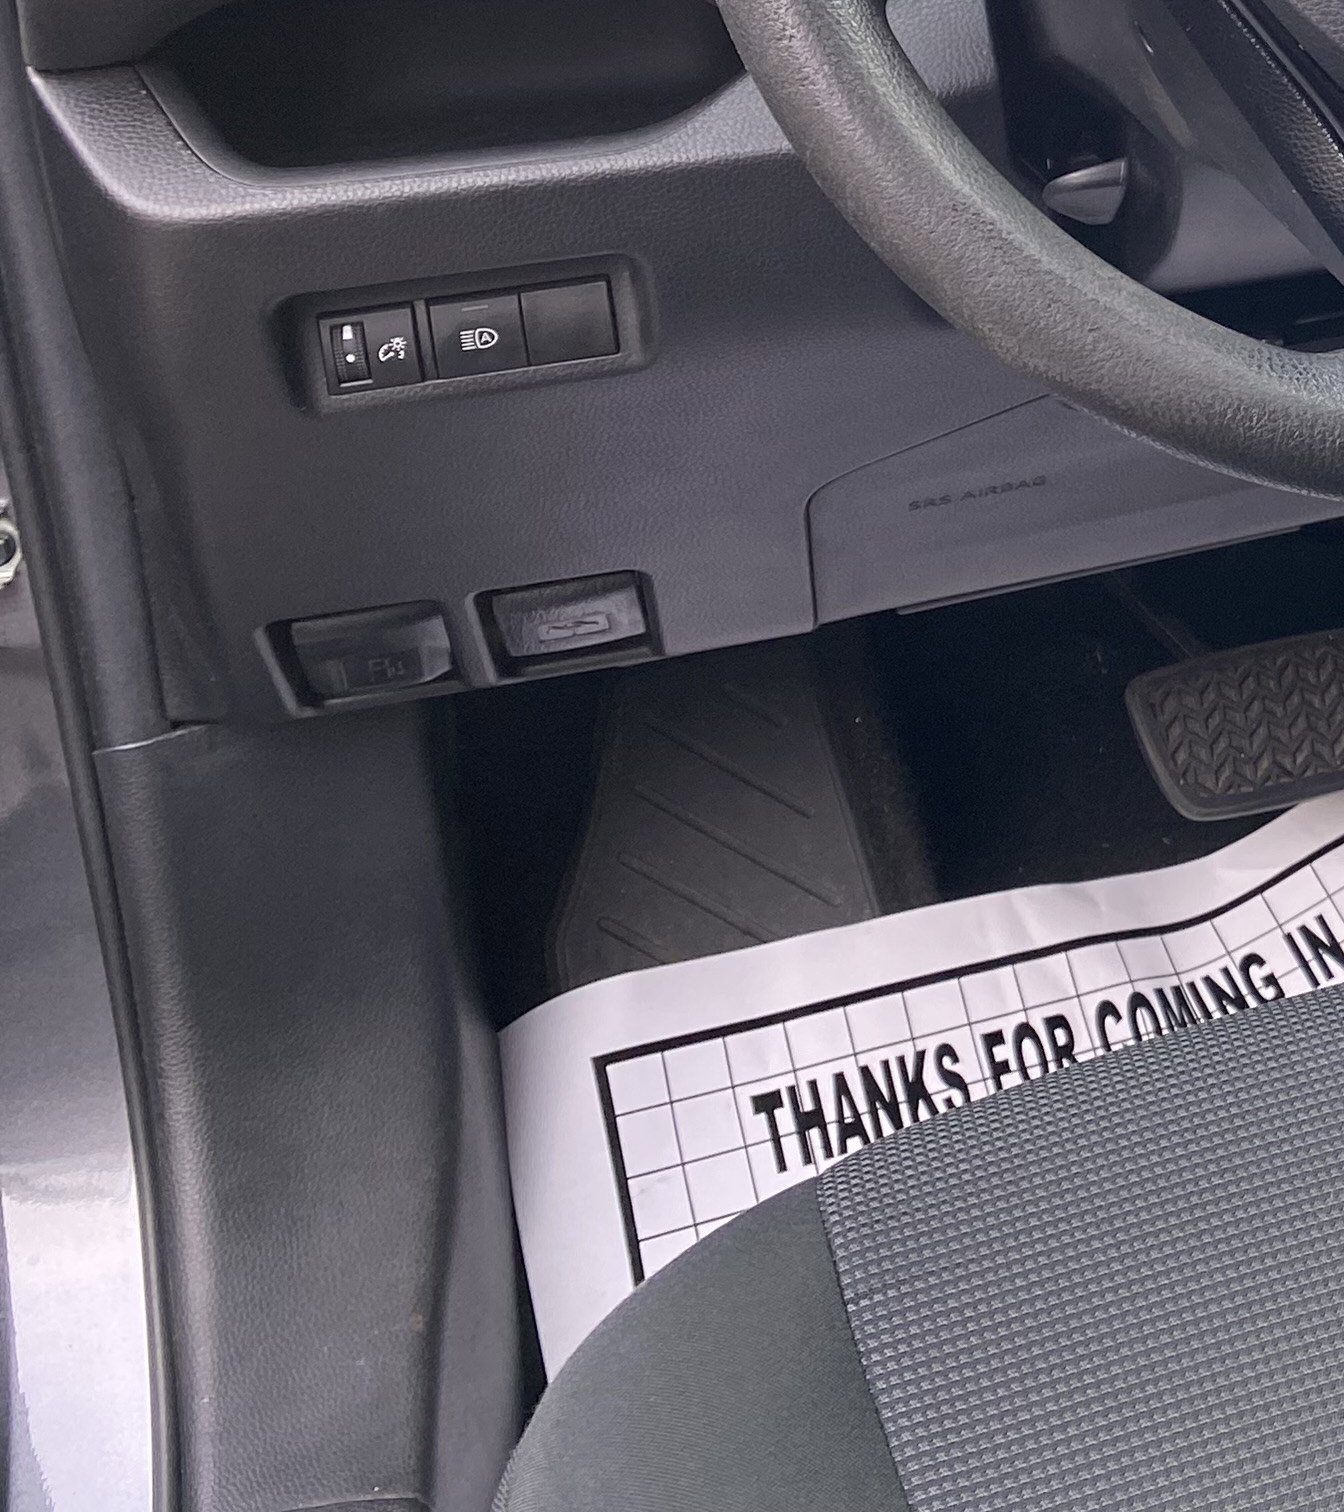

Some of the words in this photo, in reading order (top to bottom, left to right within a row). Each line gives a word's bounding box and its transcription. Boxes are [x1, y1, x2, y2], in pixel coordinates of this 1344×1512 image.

[751, 1043, 973, 1174] THANKS
[980, 1013, 1081, 1089] FOR
[1095, 952, 1286, 1052] COMING
